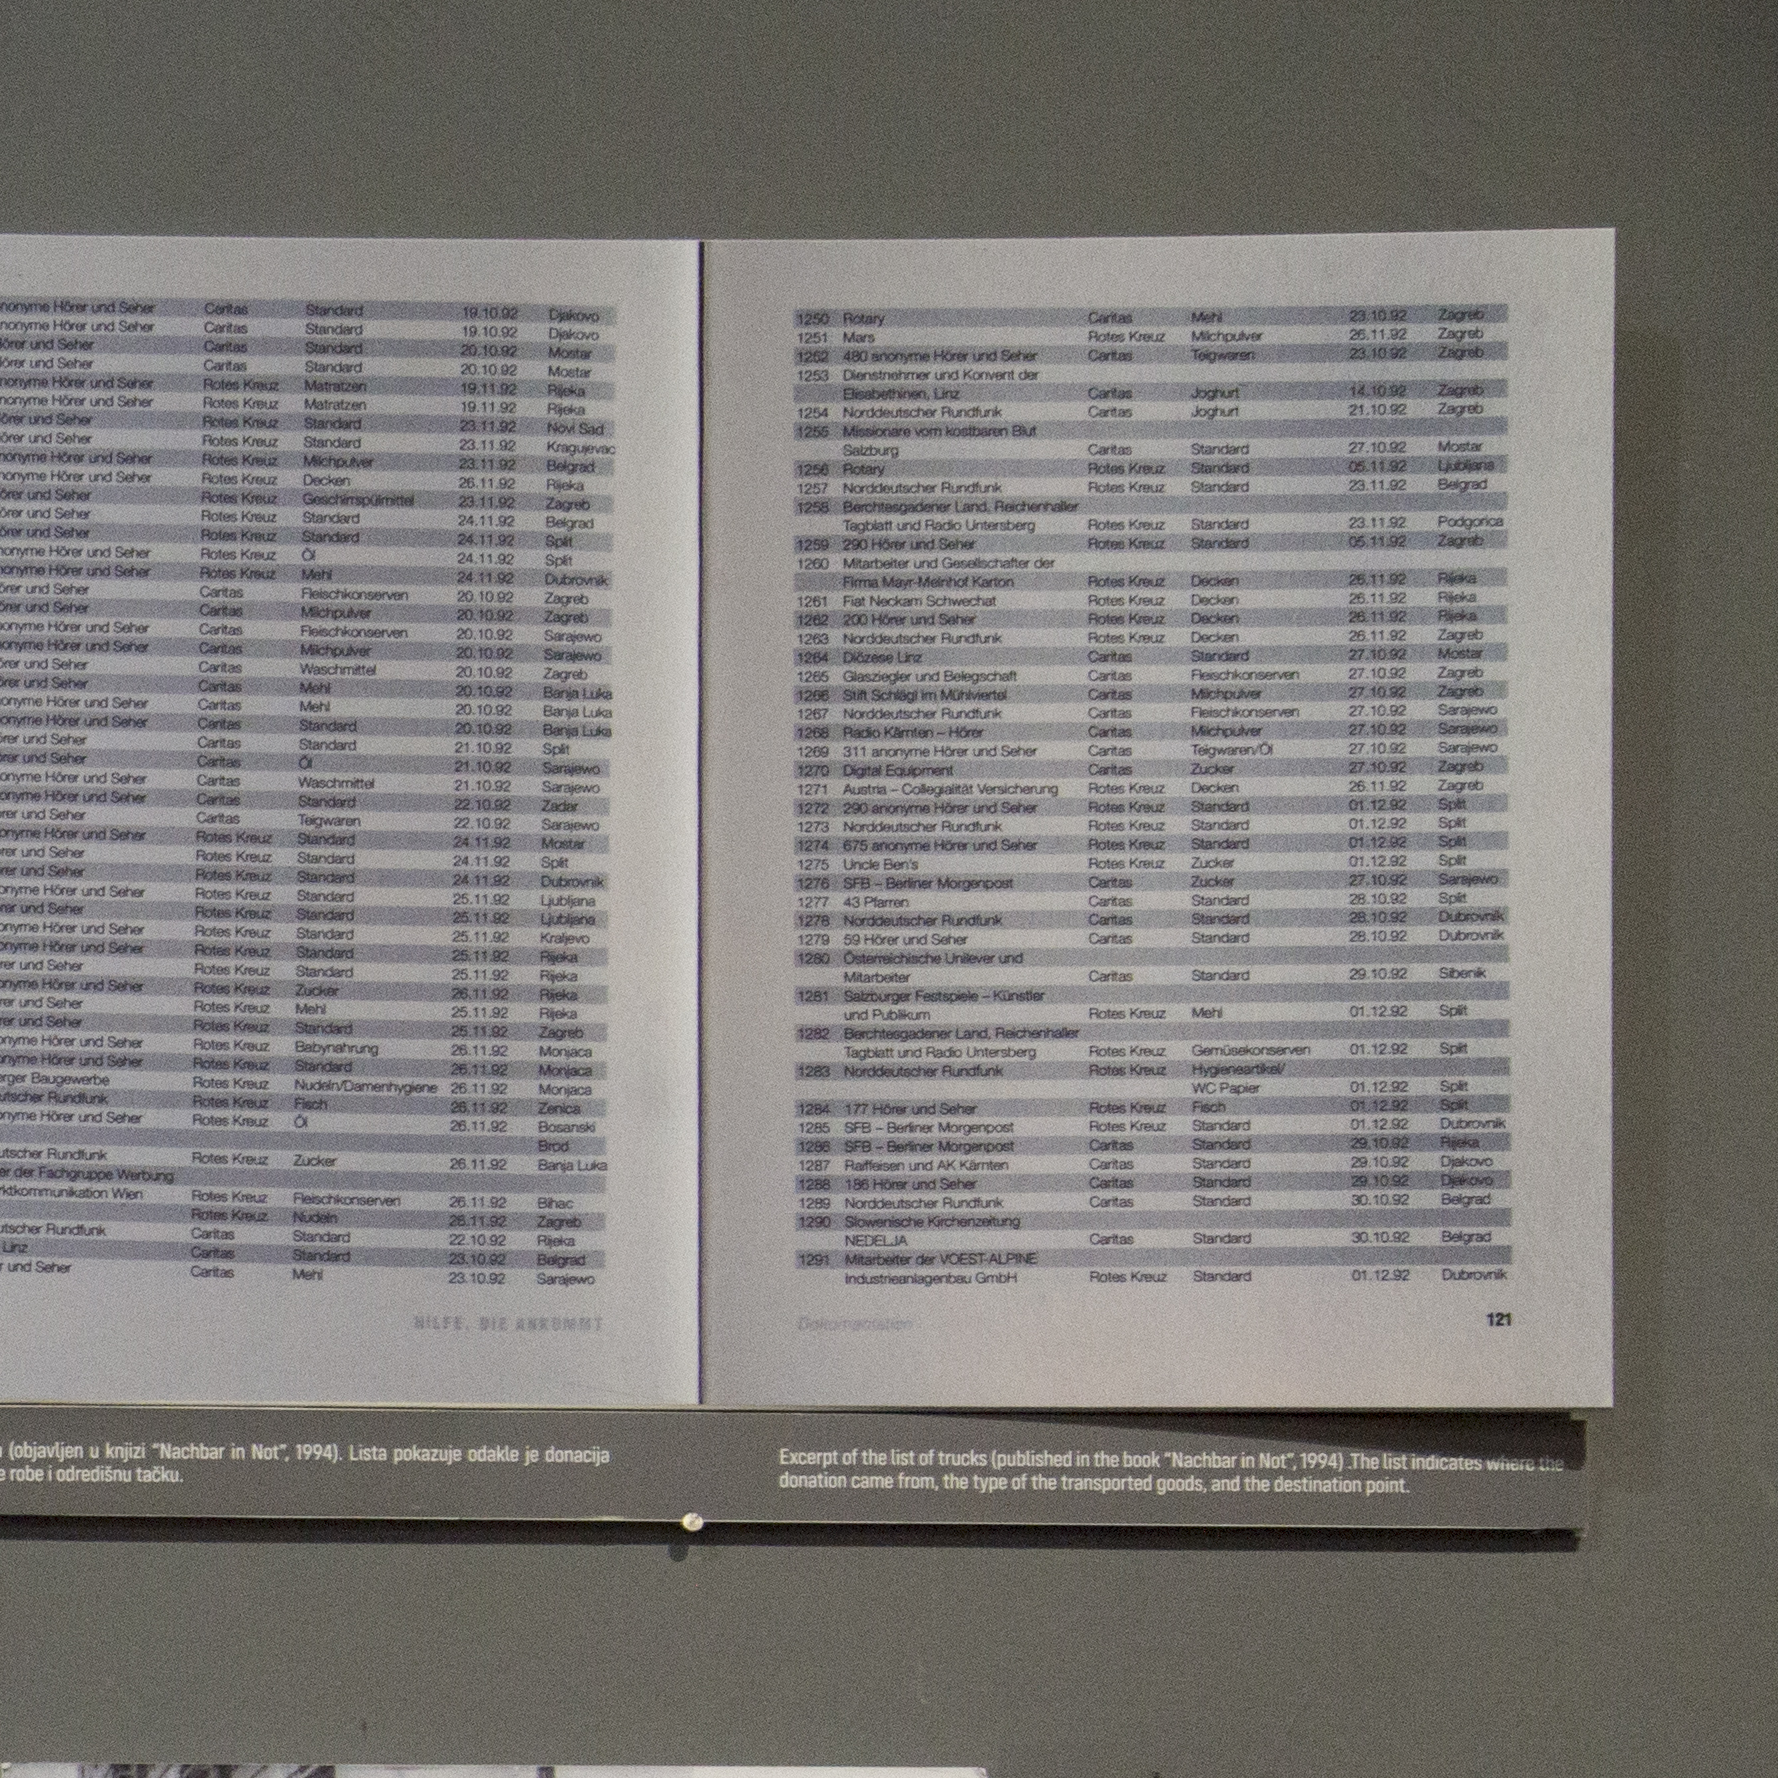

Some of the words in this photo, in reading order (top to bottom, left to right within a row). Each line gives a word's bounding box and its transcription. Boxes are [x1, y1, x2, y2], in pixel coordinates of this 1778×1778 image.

[52, 320, 87, 333] Hörer
[91, 321, 115, 332] und
[119, 320, 154, 333] Seher
[204, 322, 248, 334] Caritas
[306, 323, 363, 336] Standard
[461, 326, 519, 340] 19.10.92
[548, 326, 601, 342] Djakovo
[798, 670, 829, 684] 1265
[843, 670, 911, 686] Glasziegler
[919, 672, 940, 682] und
[943, 670, 1017, 686] Belegschaft
[1088, 669, 1133, 683] Caritas
[1191, 669, 1299, 681] Fleischkonserven
[1348, 667, 1407, 680] 27.10.92
[1436, 664, 1485, 681] Zagreb
[1486, 1311, 1513, 1328] 121
[8, 1464, 45, 1483] robe
[46, 1465, 53, 1482] i
[54, 1464, 133, 1484] odredišnu
[134, 1465, 184, 1484] tačku.
